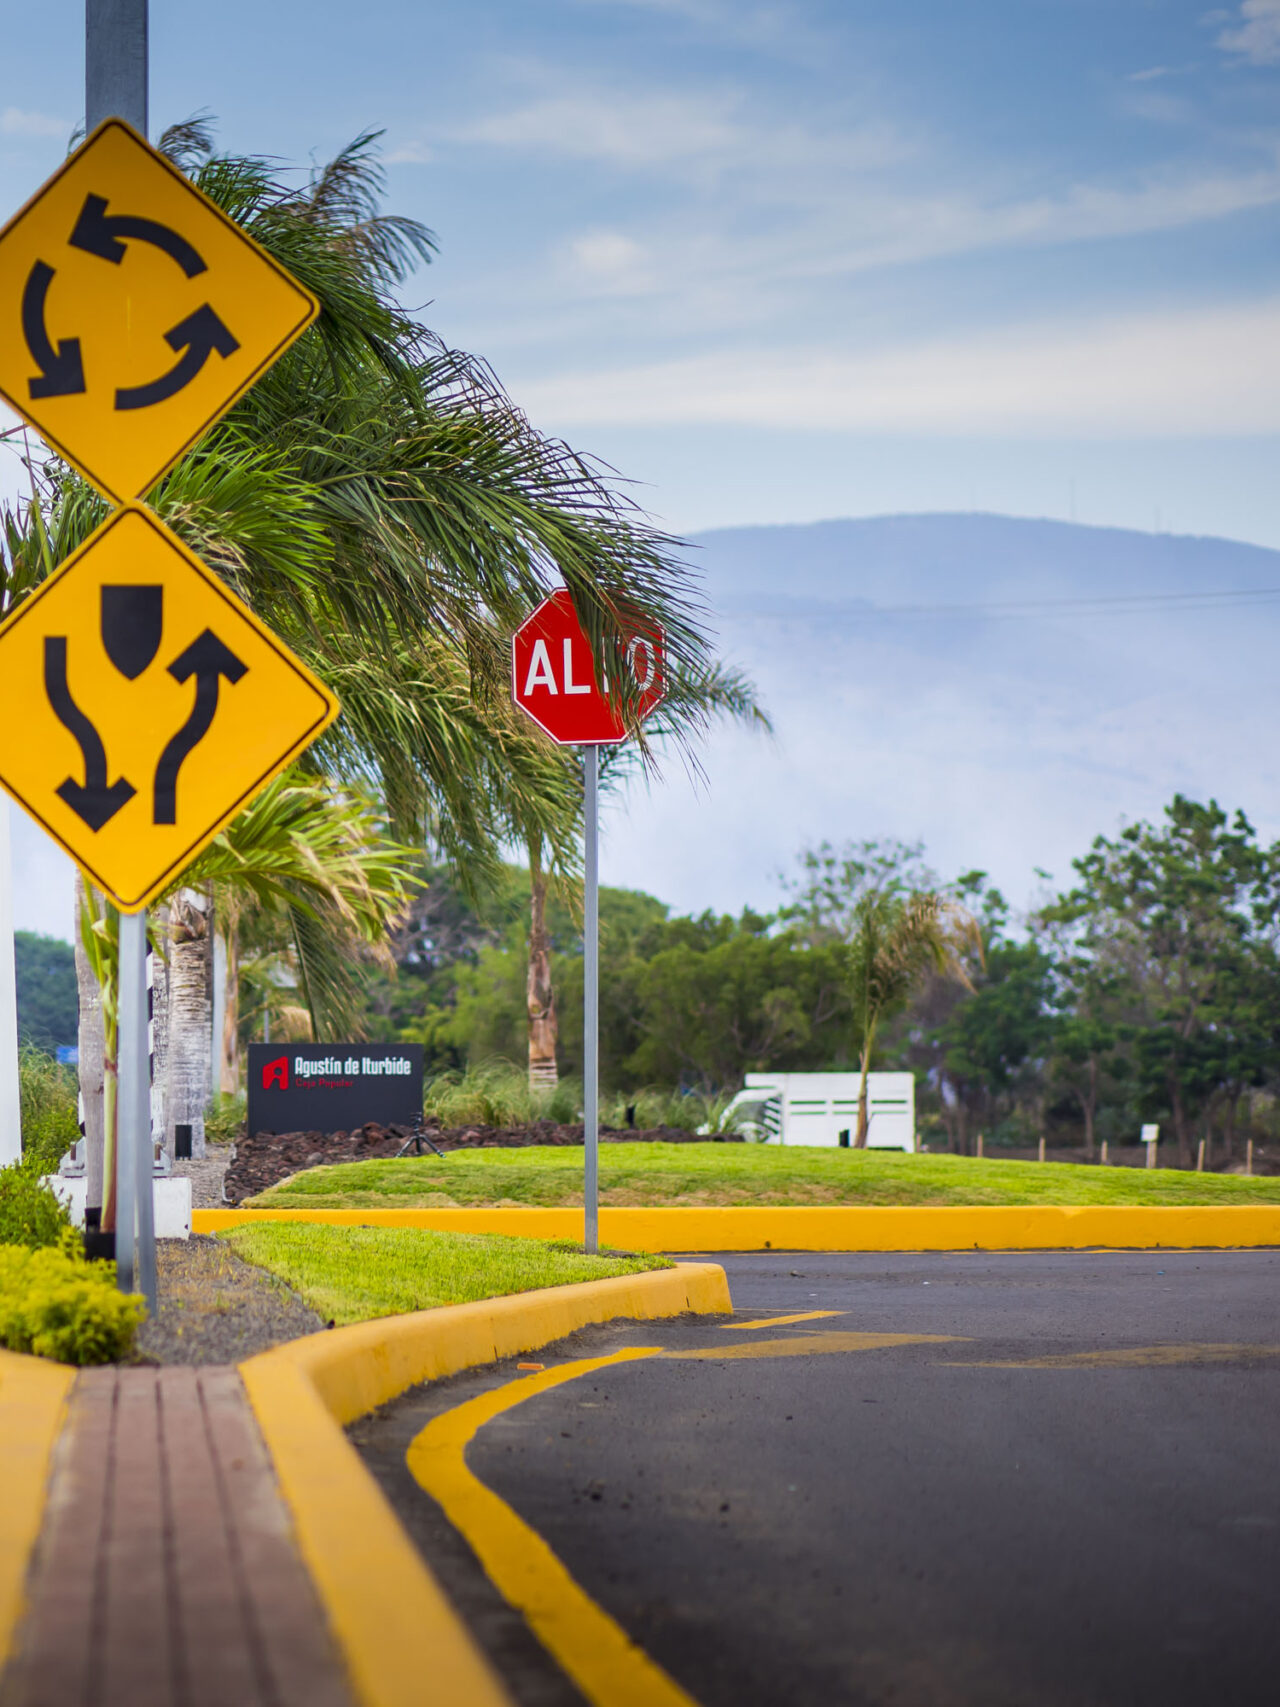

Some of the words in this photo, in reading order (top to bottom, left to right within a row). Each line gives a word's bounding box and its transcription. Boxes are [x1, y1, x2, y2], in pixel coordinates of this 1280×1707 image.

[523, 636, 656, 696] ALO
[295, 1056, 342, 1078] Agustín
[344, 1057, 360, 1075] de
[362, 1057, 412, 1075] Iturbide
[319, 1078, 354, 1089] Popular
